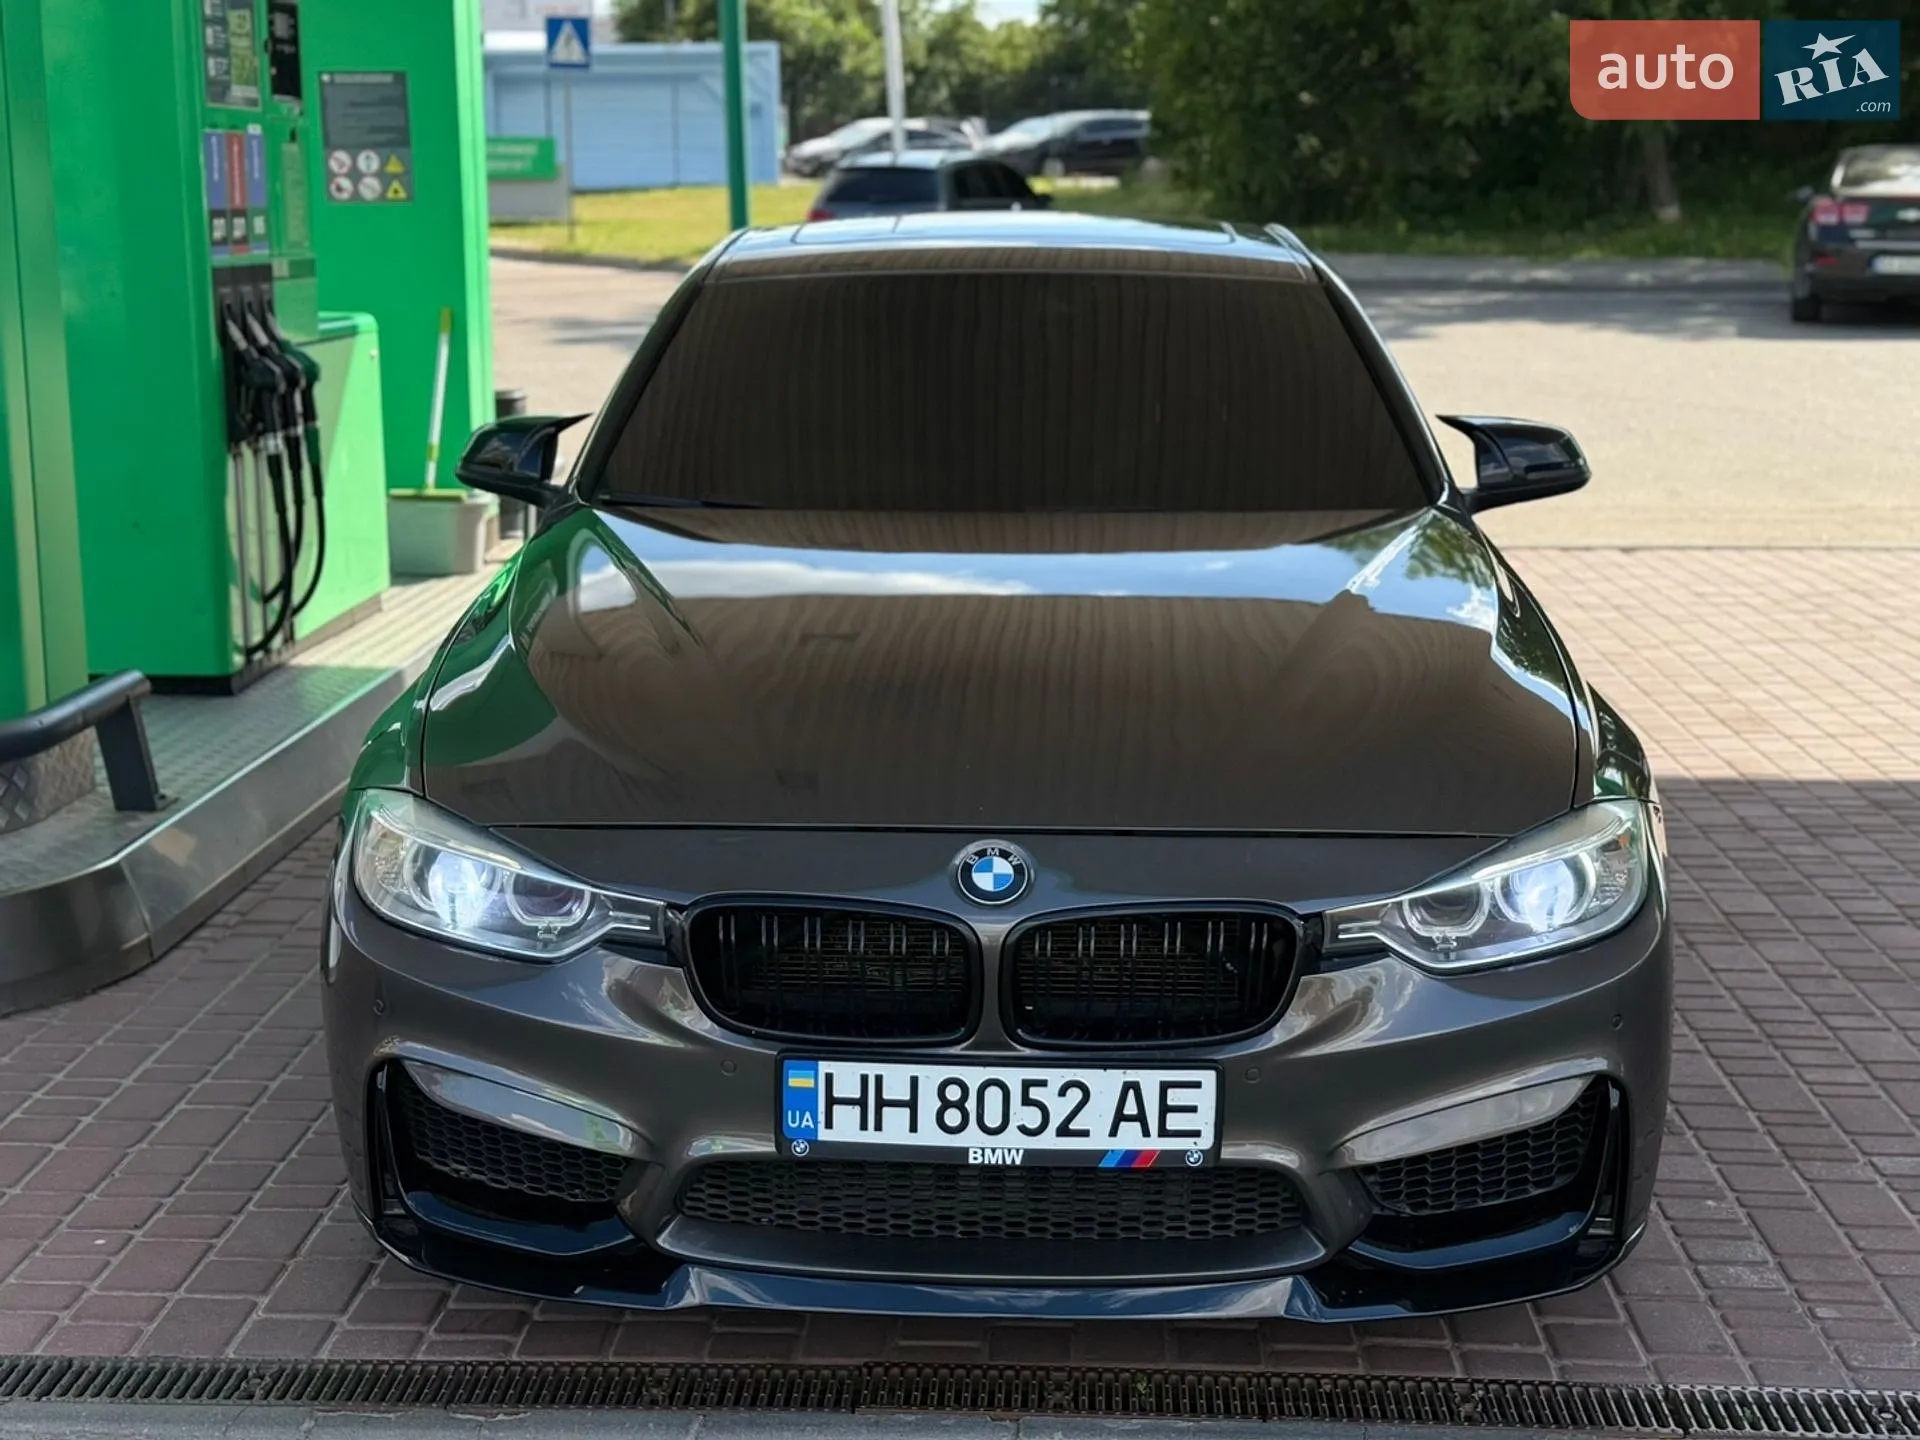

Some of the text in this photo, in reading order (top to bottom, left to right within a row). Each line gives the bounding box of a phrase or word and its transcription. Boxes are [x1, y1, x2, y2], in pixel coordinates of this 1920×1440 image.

[966, 847, 1022, 866] BMW
[824, 1072, 1204, 1139] HH 8052 AE
[788, 1110, 815, 1130] UA
[968, 1147, 1024, 1165] BMW
